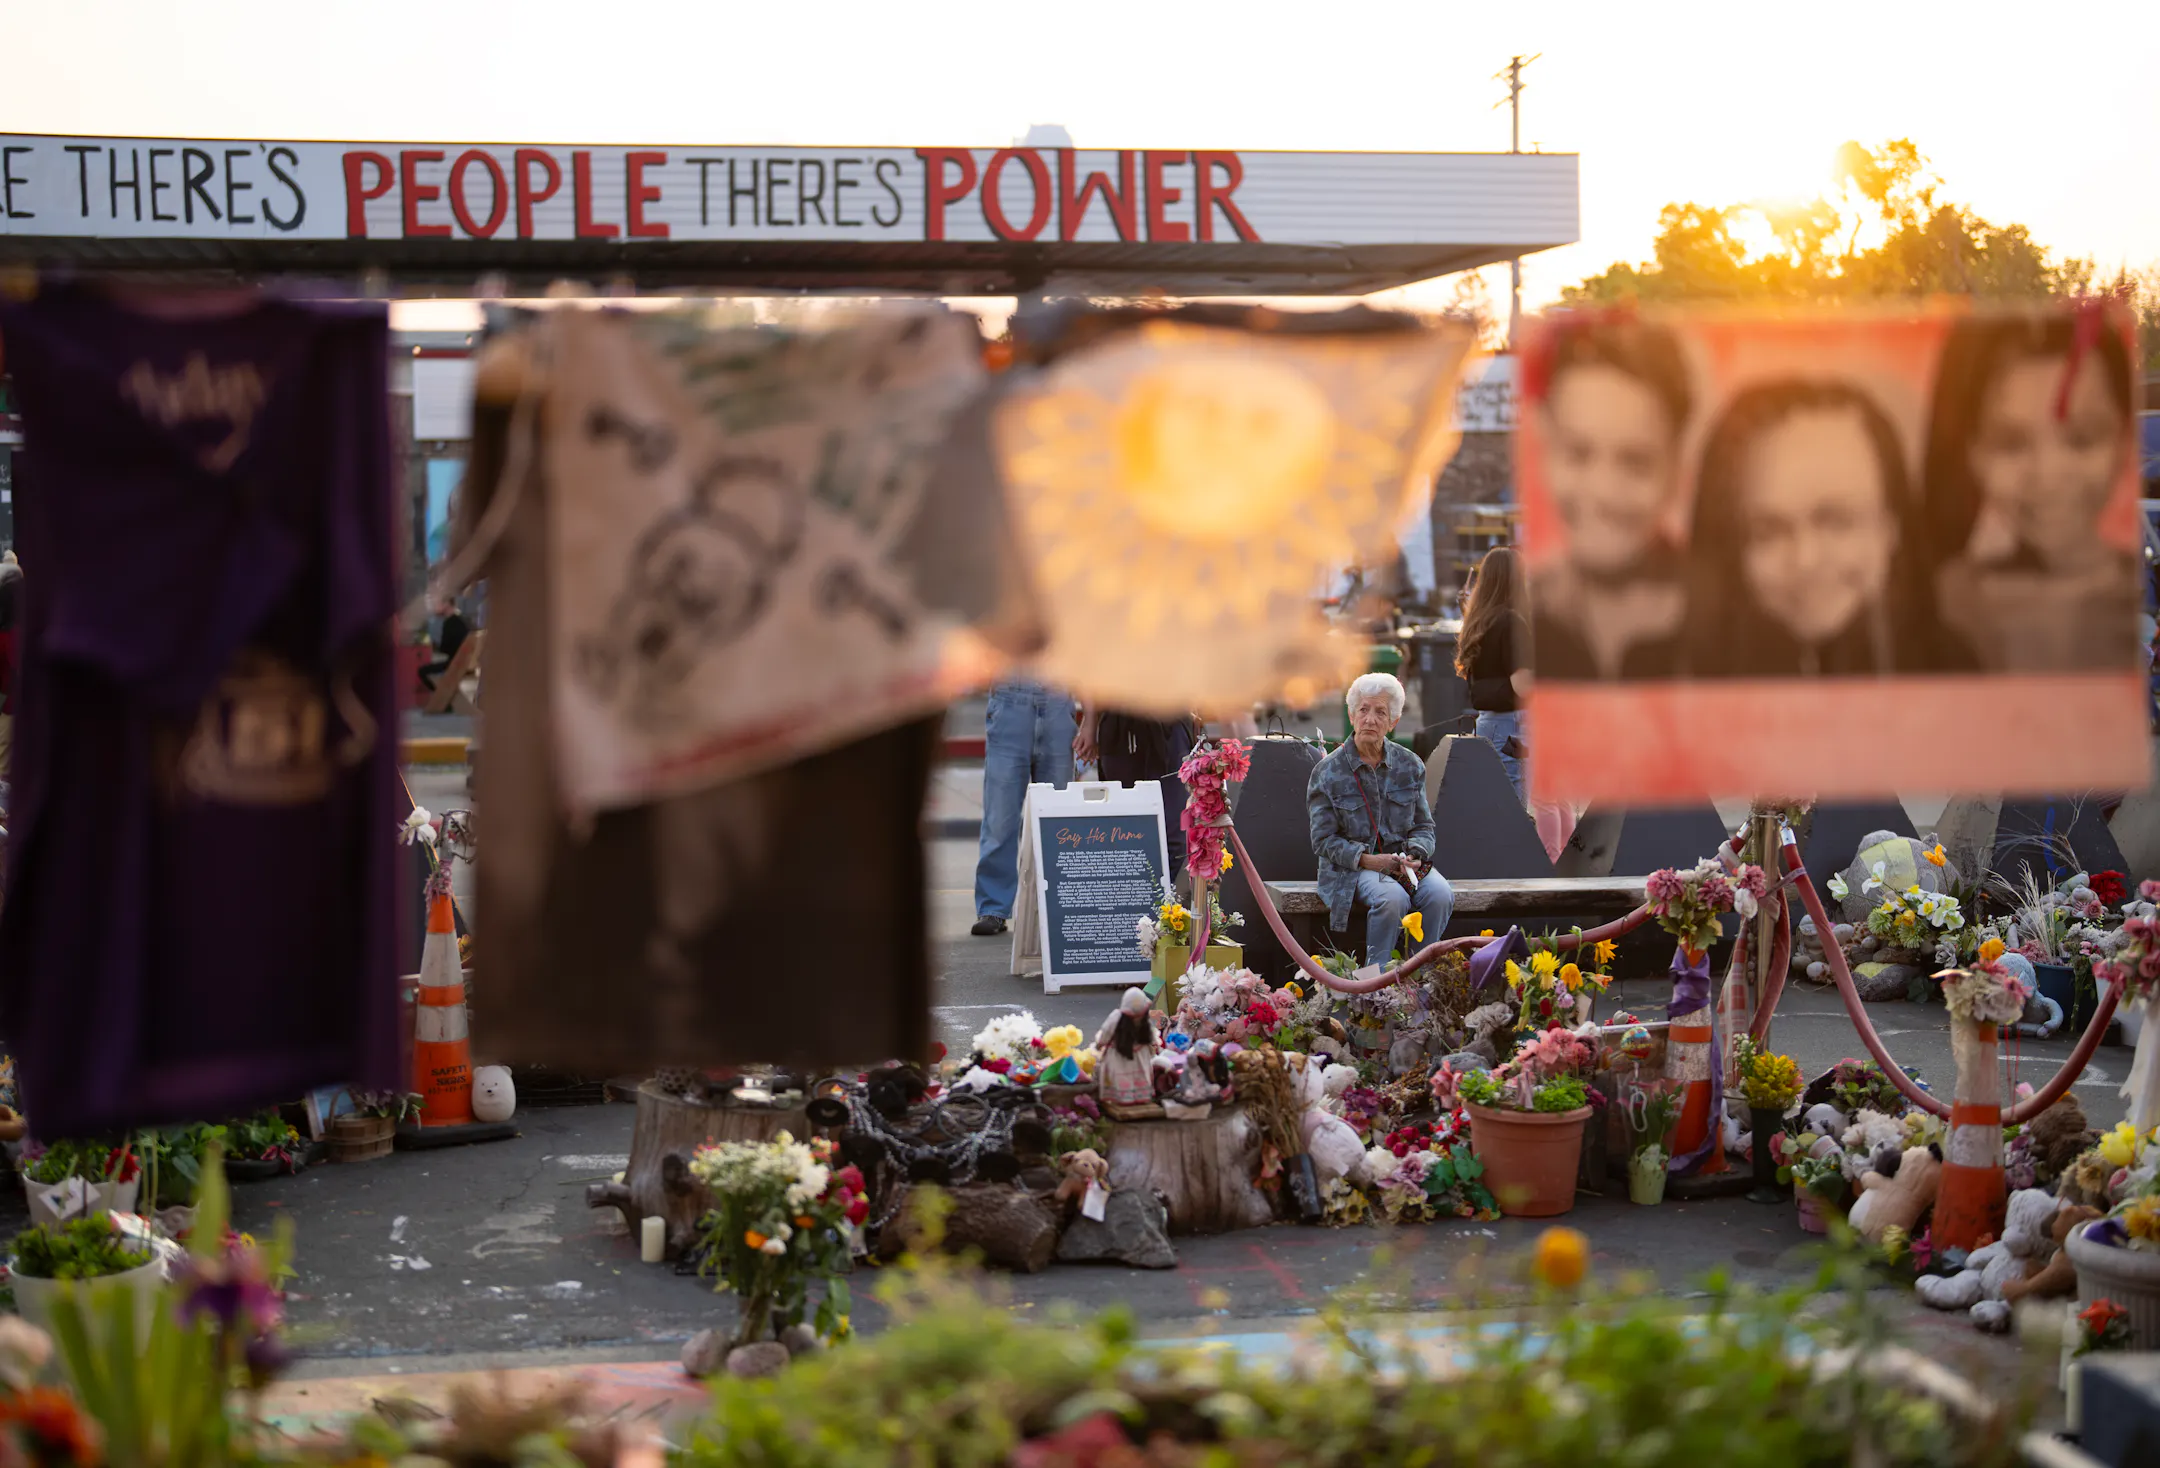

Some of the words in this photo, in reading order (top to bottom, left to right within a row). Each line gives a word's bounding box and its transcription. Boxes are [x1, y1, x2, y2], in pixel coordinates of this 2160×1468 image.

[64, 143, 305, 231] THERE'S
[343, 149, 670, 238] PEOPLE
[686, 156, 903, 228] THERE'S
[915, 147, 1262, 242] POWER
[1056, 828, 1082, 848] Say
[1086, 827, 1108, 844] His
[1111, 827, 1144, 842] Name
